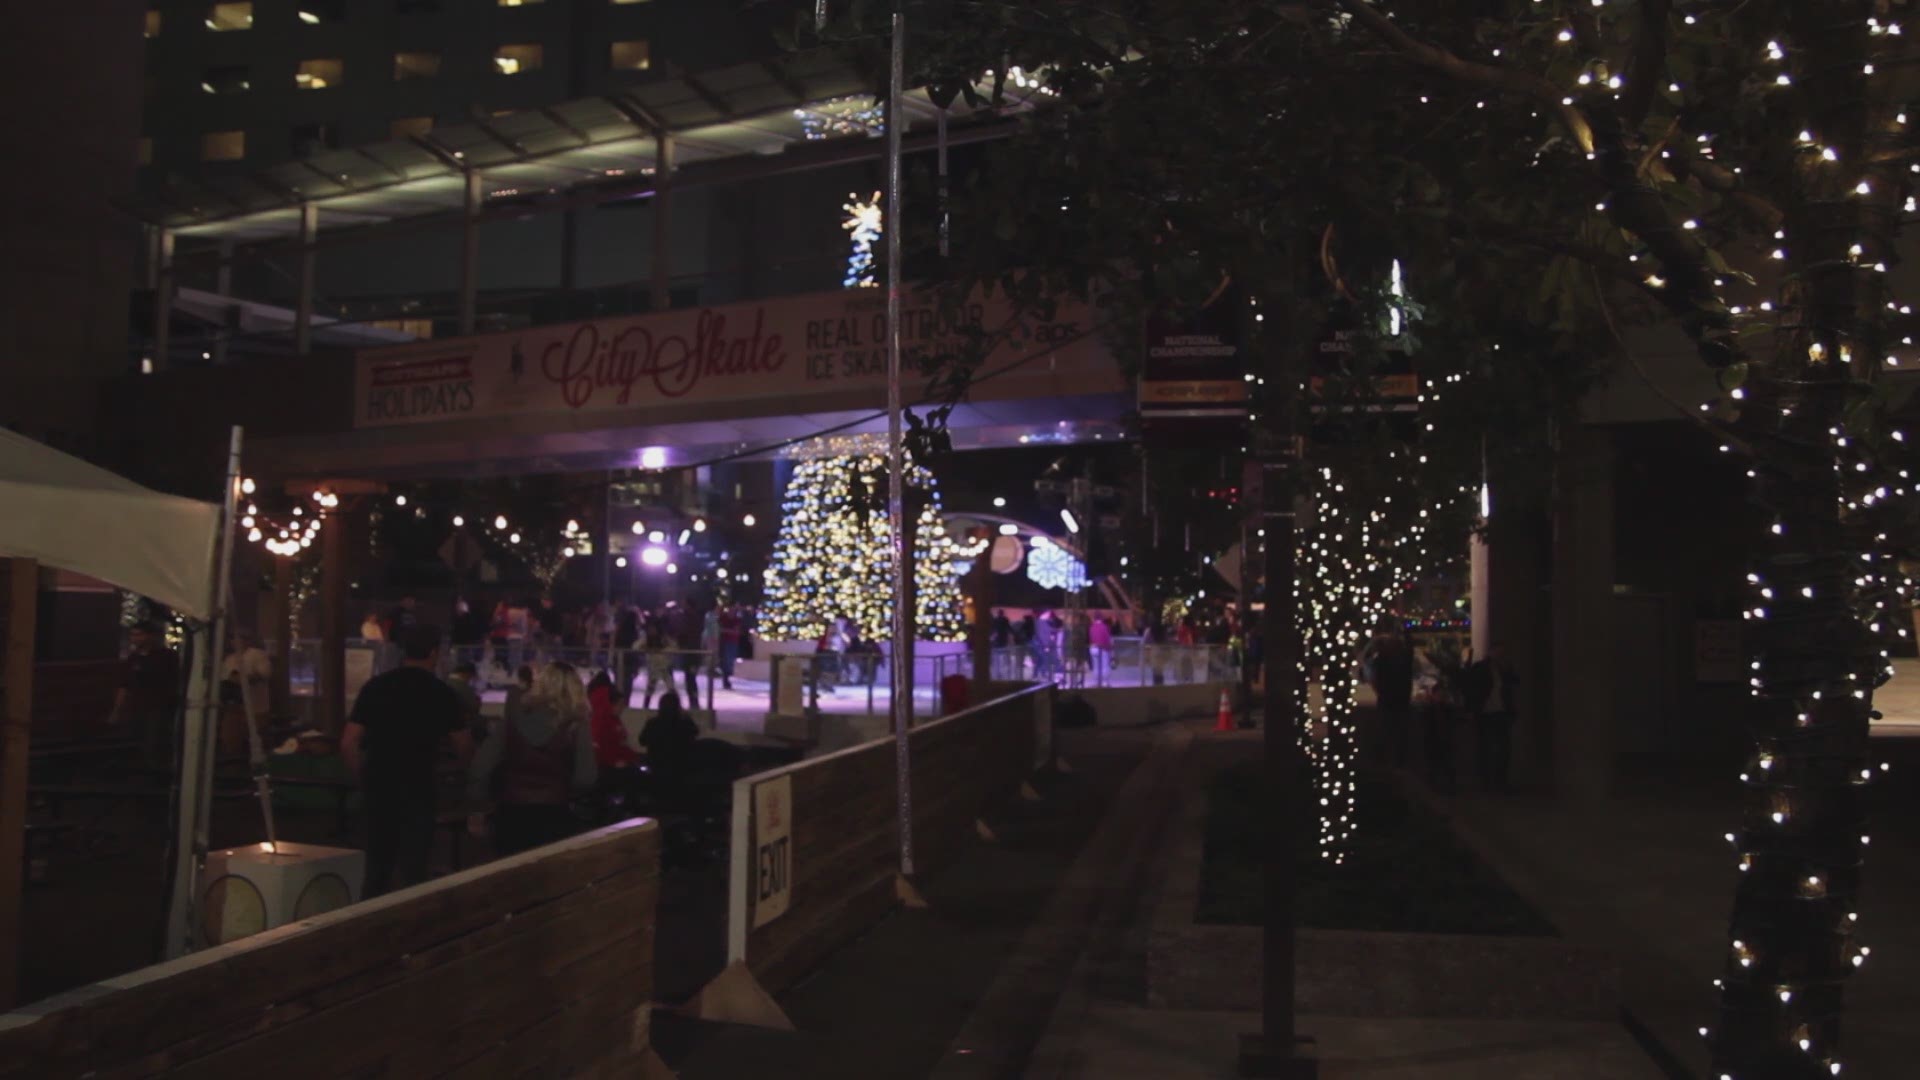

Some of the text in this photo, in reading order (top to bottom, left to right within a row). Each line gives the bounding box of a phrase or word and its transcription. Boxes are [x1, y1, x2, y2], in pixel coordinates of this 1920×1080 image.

[807, 316, 862, 349] REAL
[1164, 335, 1223, 346] NATIONAL
[541, 307, 788, 408] City Skate
[806, 353, 837, 380] ICE
[368, 379, 474, 419] HOLIDAYS
[759, 835, 788, 901] EXIT
